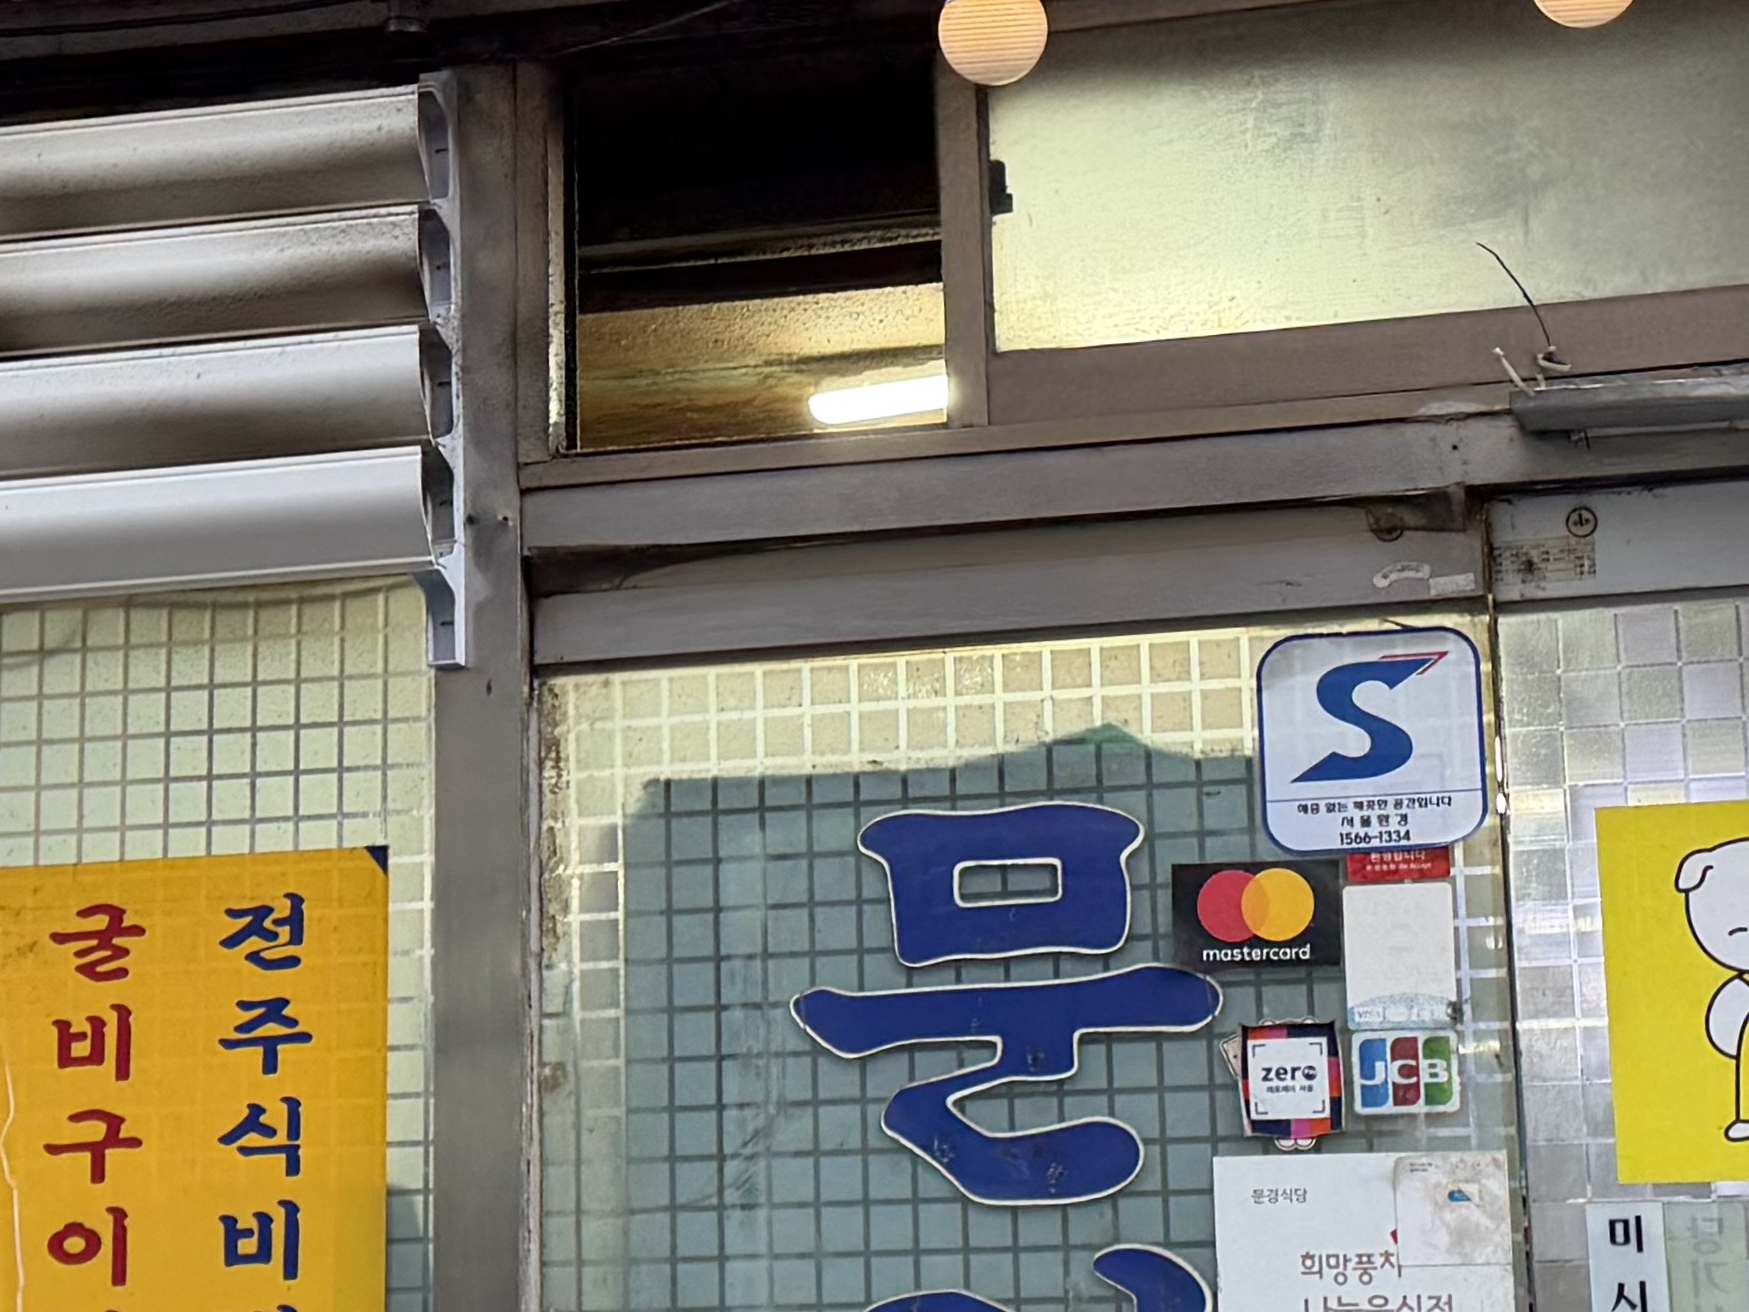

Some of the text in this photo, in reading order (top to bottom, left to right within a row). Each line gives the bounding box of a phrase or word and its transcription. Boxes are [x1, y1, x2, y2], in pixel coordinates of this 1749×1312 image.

[1339, 830, 1411, 846] 1566-1334
[1202, 944, 1311, 962] mastercard
[1261, 1065, 1317, 1081] zero
[1252, 1188, 1308, 1204] 문경식당
